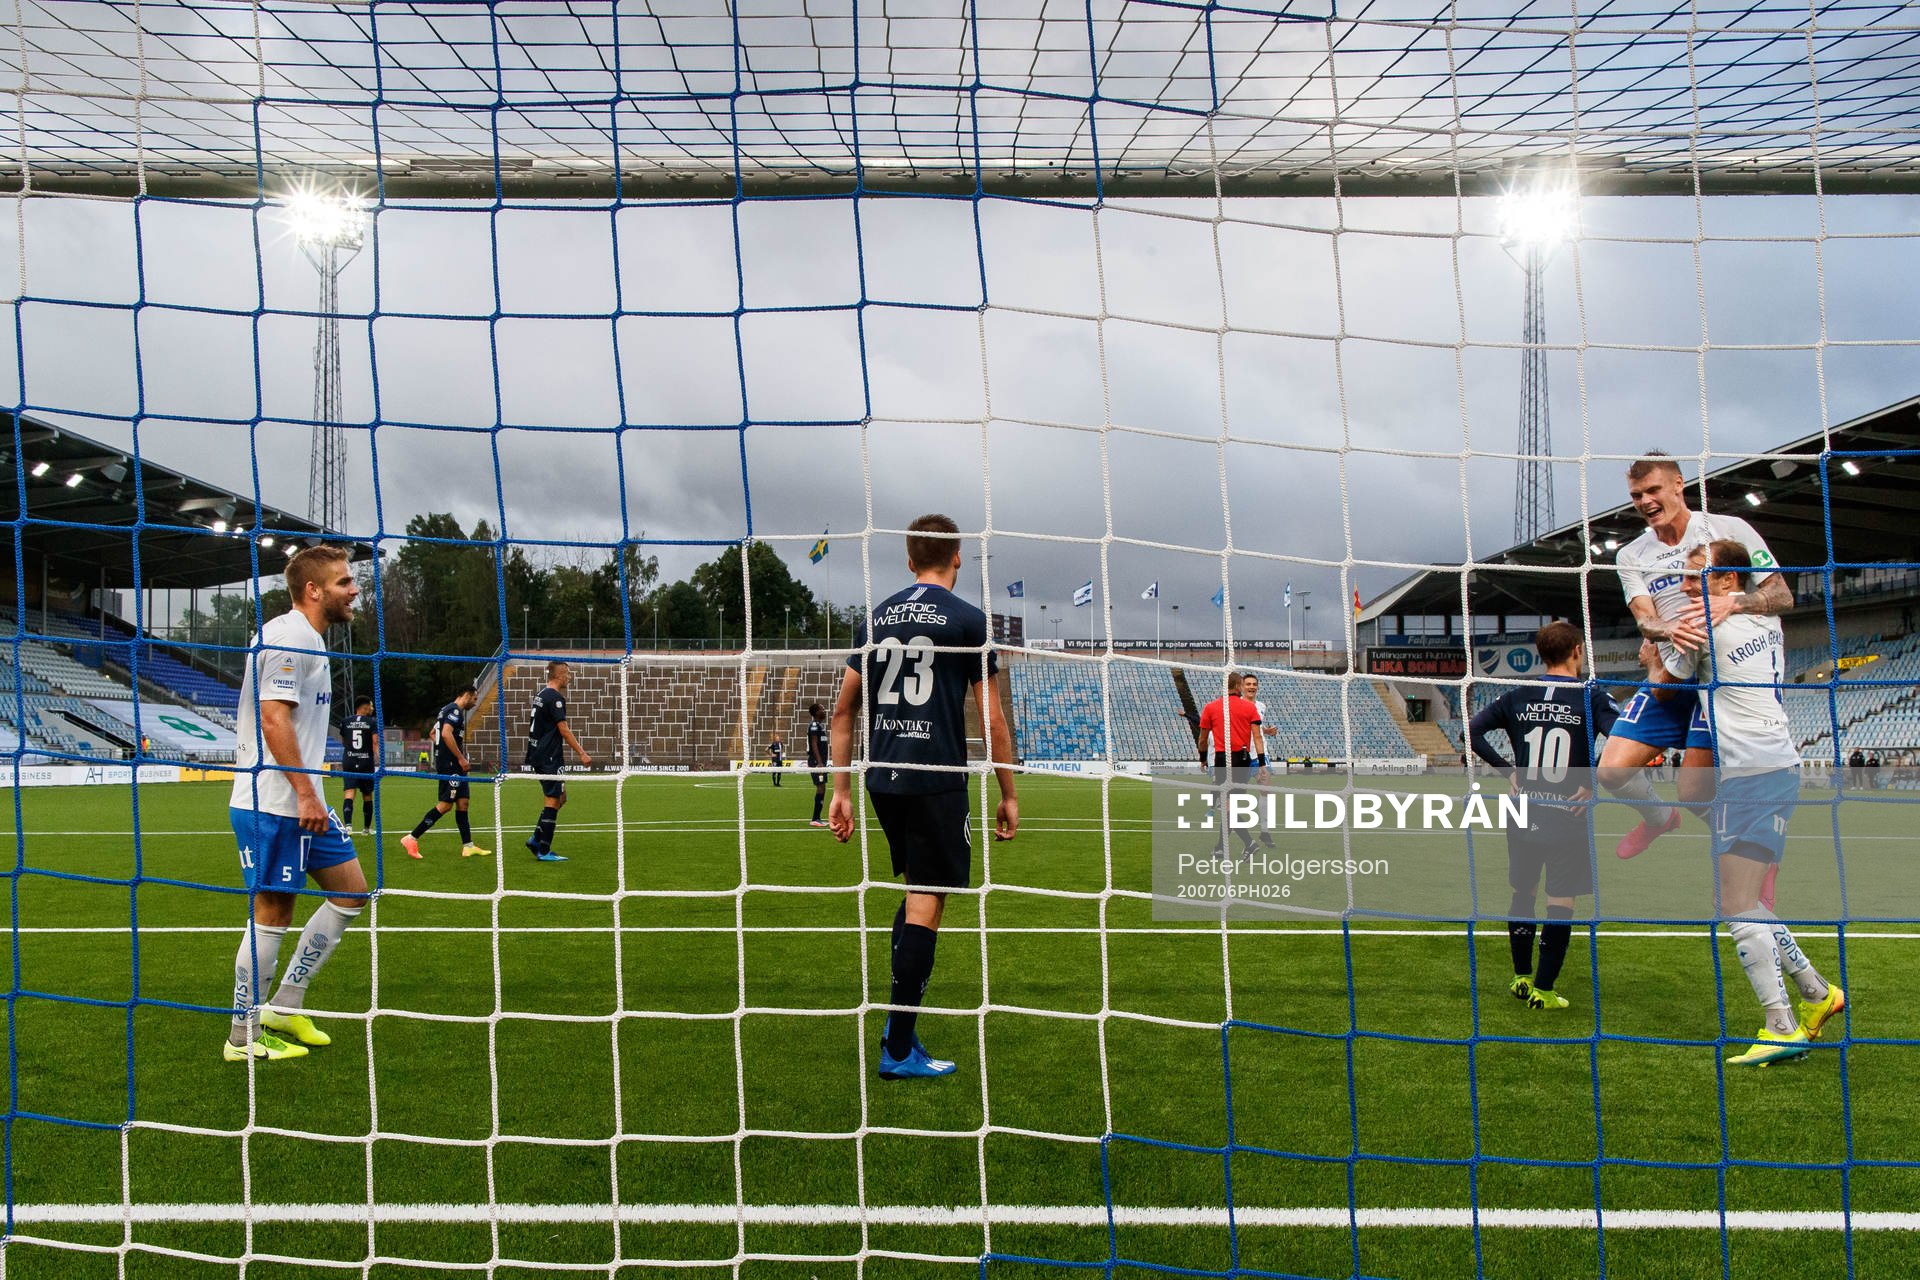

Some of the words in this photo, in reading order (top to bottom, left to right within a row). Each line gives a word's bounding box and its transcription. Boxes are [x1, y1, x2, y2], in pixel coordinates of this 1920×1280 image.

[885, 602, 938, 616] NORDIC
[874, 612, 948, 627] WELLNESS
[1727, 635, 1768, 665] KROGH
[876, 635, 935, 706] 23
[1372, 660, 1404, 673] LIKA
[1526, 703, 1572, 714] NORDIC
[882, 719, 933, 732] KONTAKT
[1516, 712, 1582, 725] WELLNESS
[352, 729, 363, 750] 5
[1524, 726, 1571, 783] 10
[9, 772, 52, 780] BSINESS
[1371, 764, 1404, 774] Askling
[1407, 764, 1419, 772] Bil
[281, 865, 292, 882] 5
